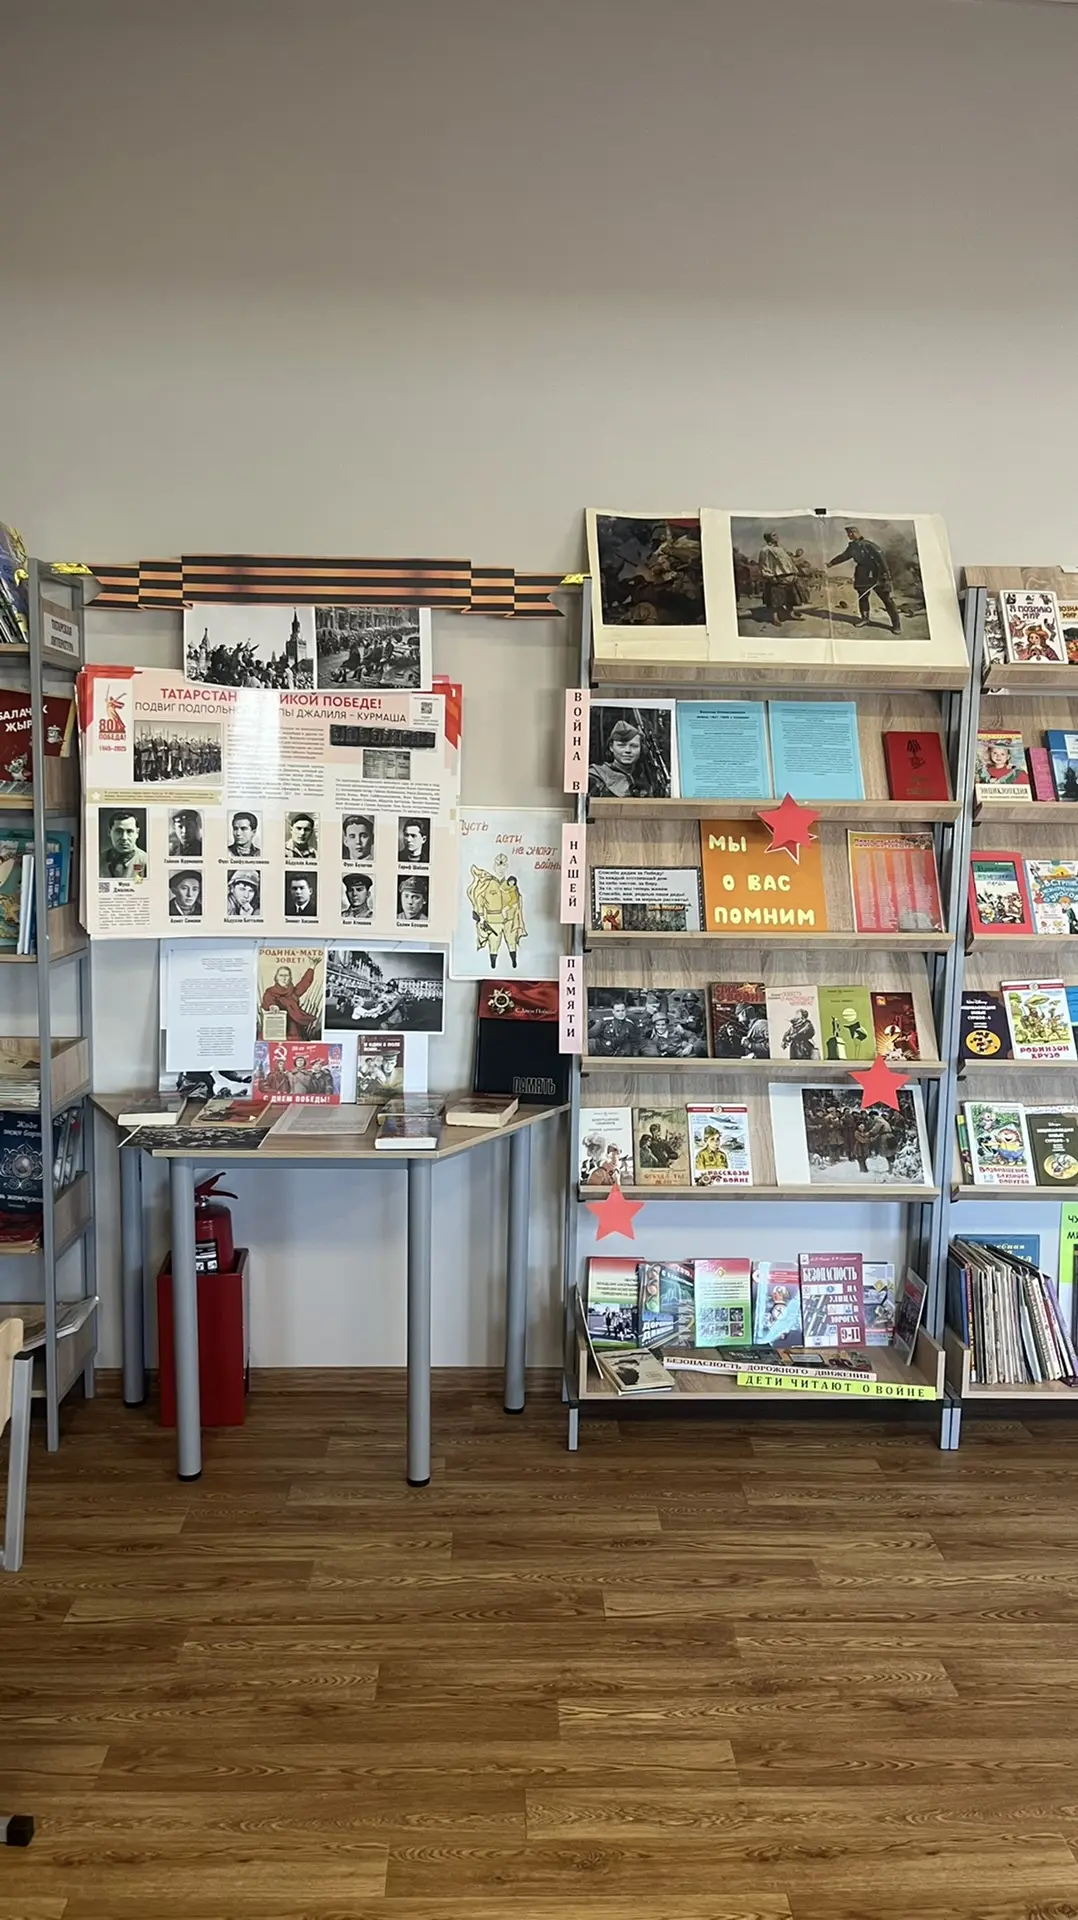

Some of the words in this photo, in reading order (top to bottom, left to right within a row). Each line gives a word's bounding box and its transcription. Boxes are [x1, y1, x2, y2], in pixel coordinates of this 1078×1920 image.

[160, 688, 237, 702] ТАТАРСТАН
[280, 692, 318, 706] ИКОЙ
[322, 696, 382, 710] ПОБЕДЕ!
[135, 702, 176, 712] ПОДВИГ
[178, 703, 237, 714] ПОДПОЛЬН
[296, 708, 347, 720] ДЖАЛИЛЯ
[357, 712, 407, 722] КУРМАША
[98, 732, 126, 740] ПОБЕДА!
[572, 692, 582, 762] ВОЙНА
[708, 834, 748, 852] МЫ
[568, 841, 579, 907] НАШЕЙ
[722, 874, 735, 891] О
[748, 874, 791, 892] ВАС
[714, 906, 816, 926] ПОМНИМ
[566, 959, 575, 1037] ПАМЯТИ
[513, 1076, 556, 1094] ПАМЯТЬ
[802, 1266, 857, 1282] БЕЗОПАСНОСТЬ
[666, 1357, 742, 1371] БЕЗОПАСНОСТЬ
[747, 1364, 808, 1374] ДОРОЖНОГО
[814, 1370, 870, 1380] ДВИЖЕНИЯ
[746, 1376, 783, 1386] ДЕТИ
[791, 1378, 852, 1392] ЧИТАЮТ
[862, 1383, 870, 1393] О
[876, 1384, 925, 1398] ВОЙНЕ
